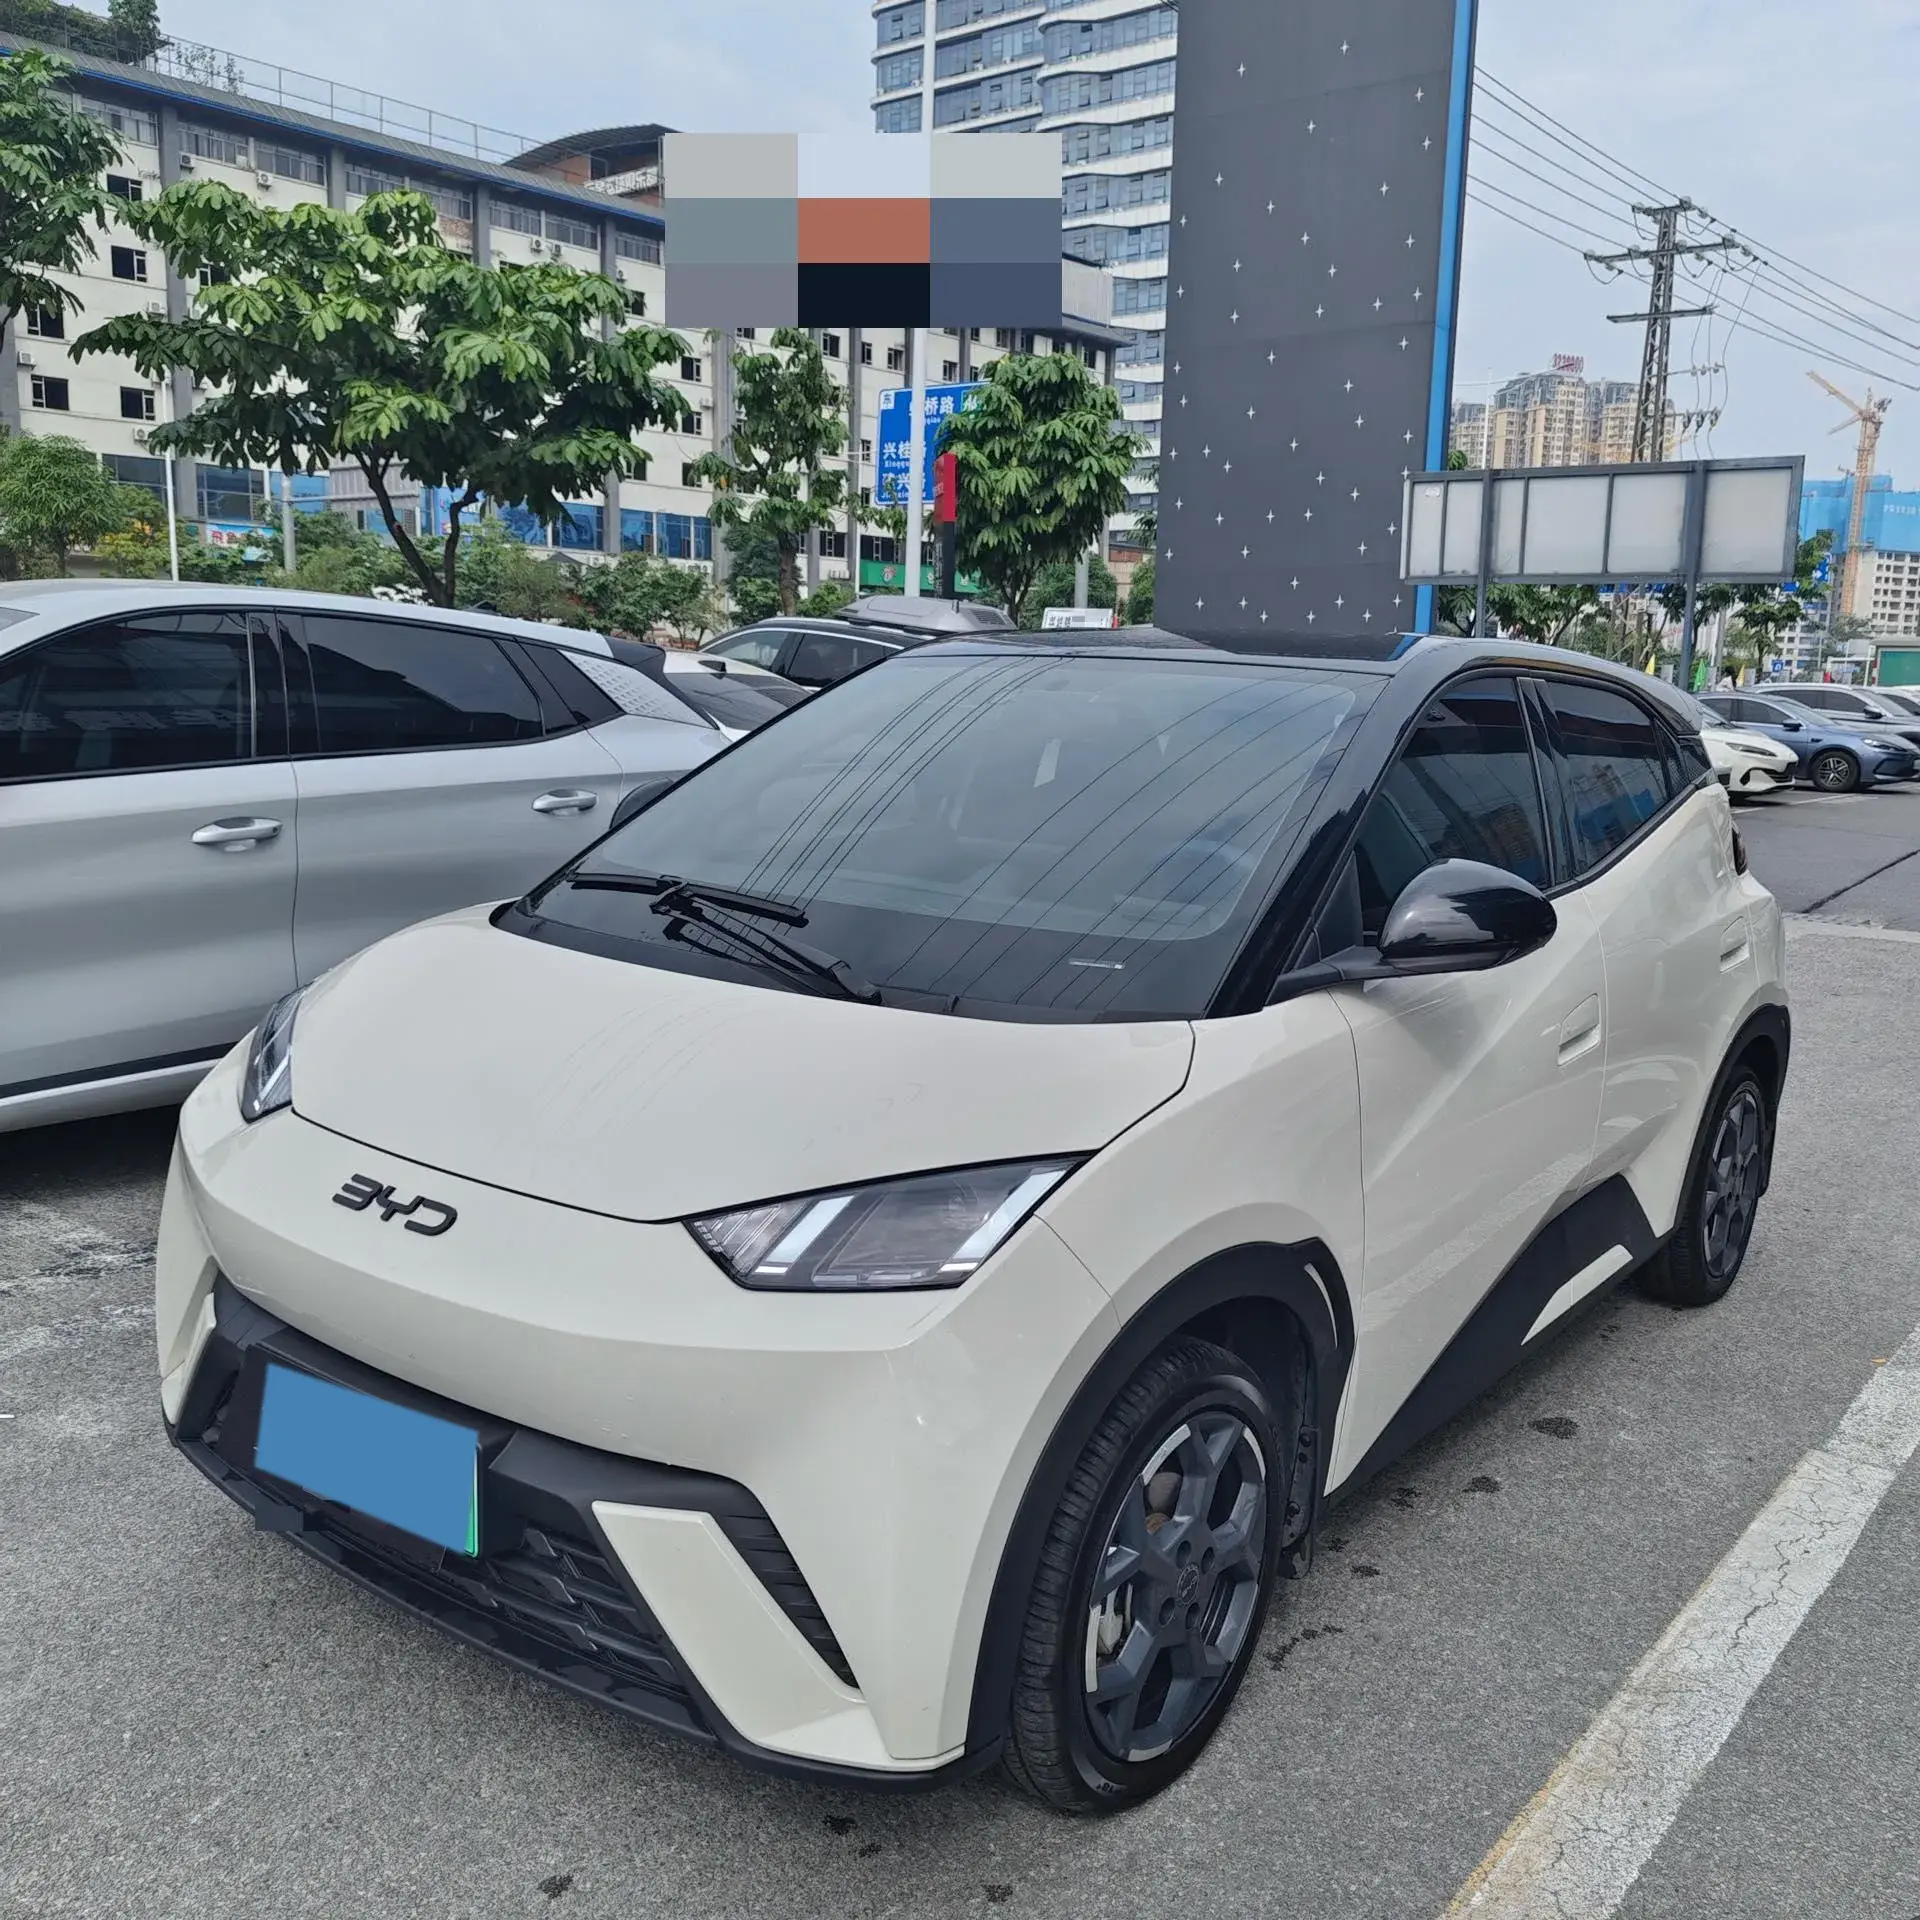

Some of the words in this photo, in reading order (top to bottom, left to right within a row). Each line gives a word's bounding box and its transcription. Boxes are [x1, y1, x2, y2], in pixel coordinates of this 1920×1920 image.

[909, 396, 954, 416] 桥路
[883, 441, 927, 460] 兴桂
[332, 1173, 458, 1237] BYD
